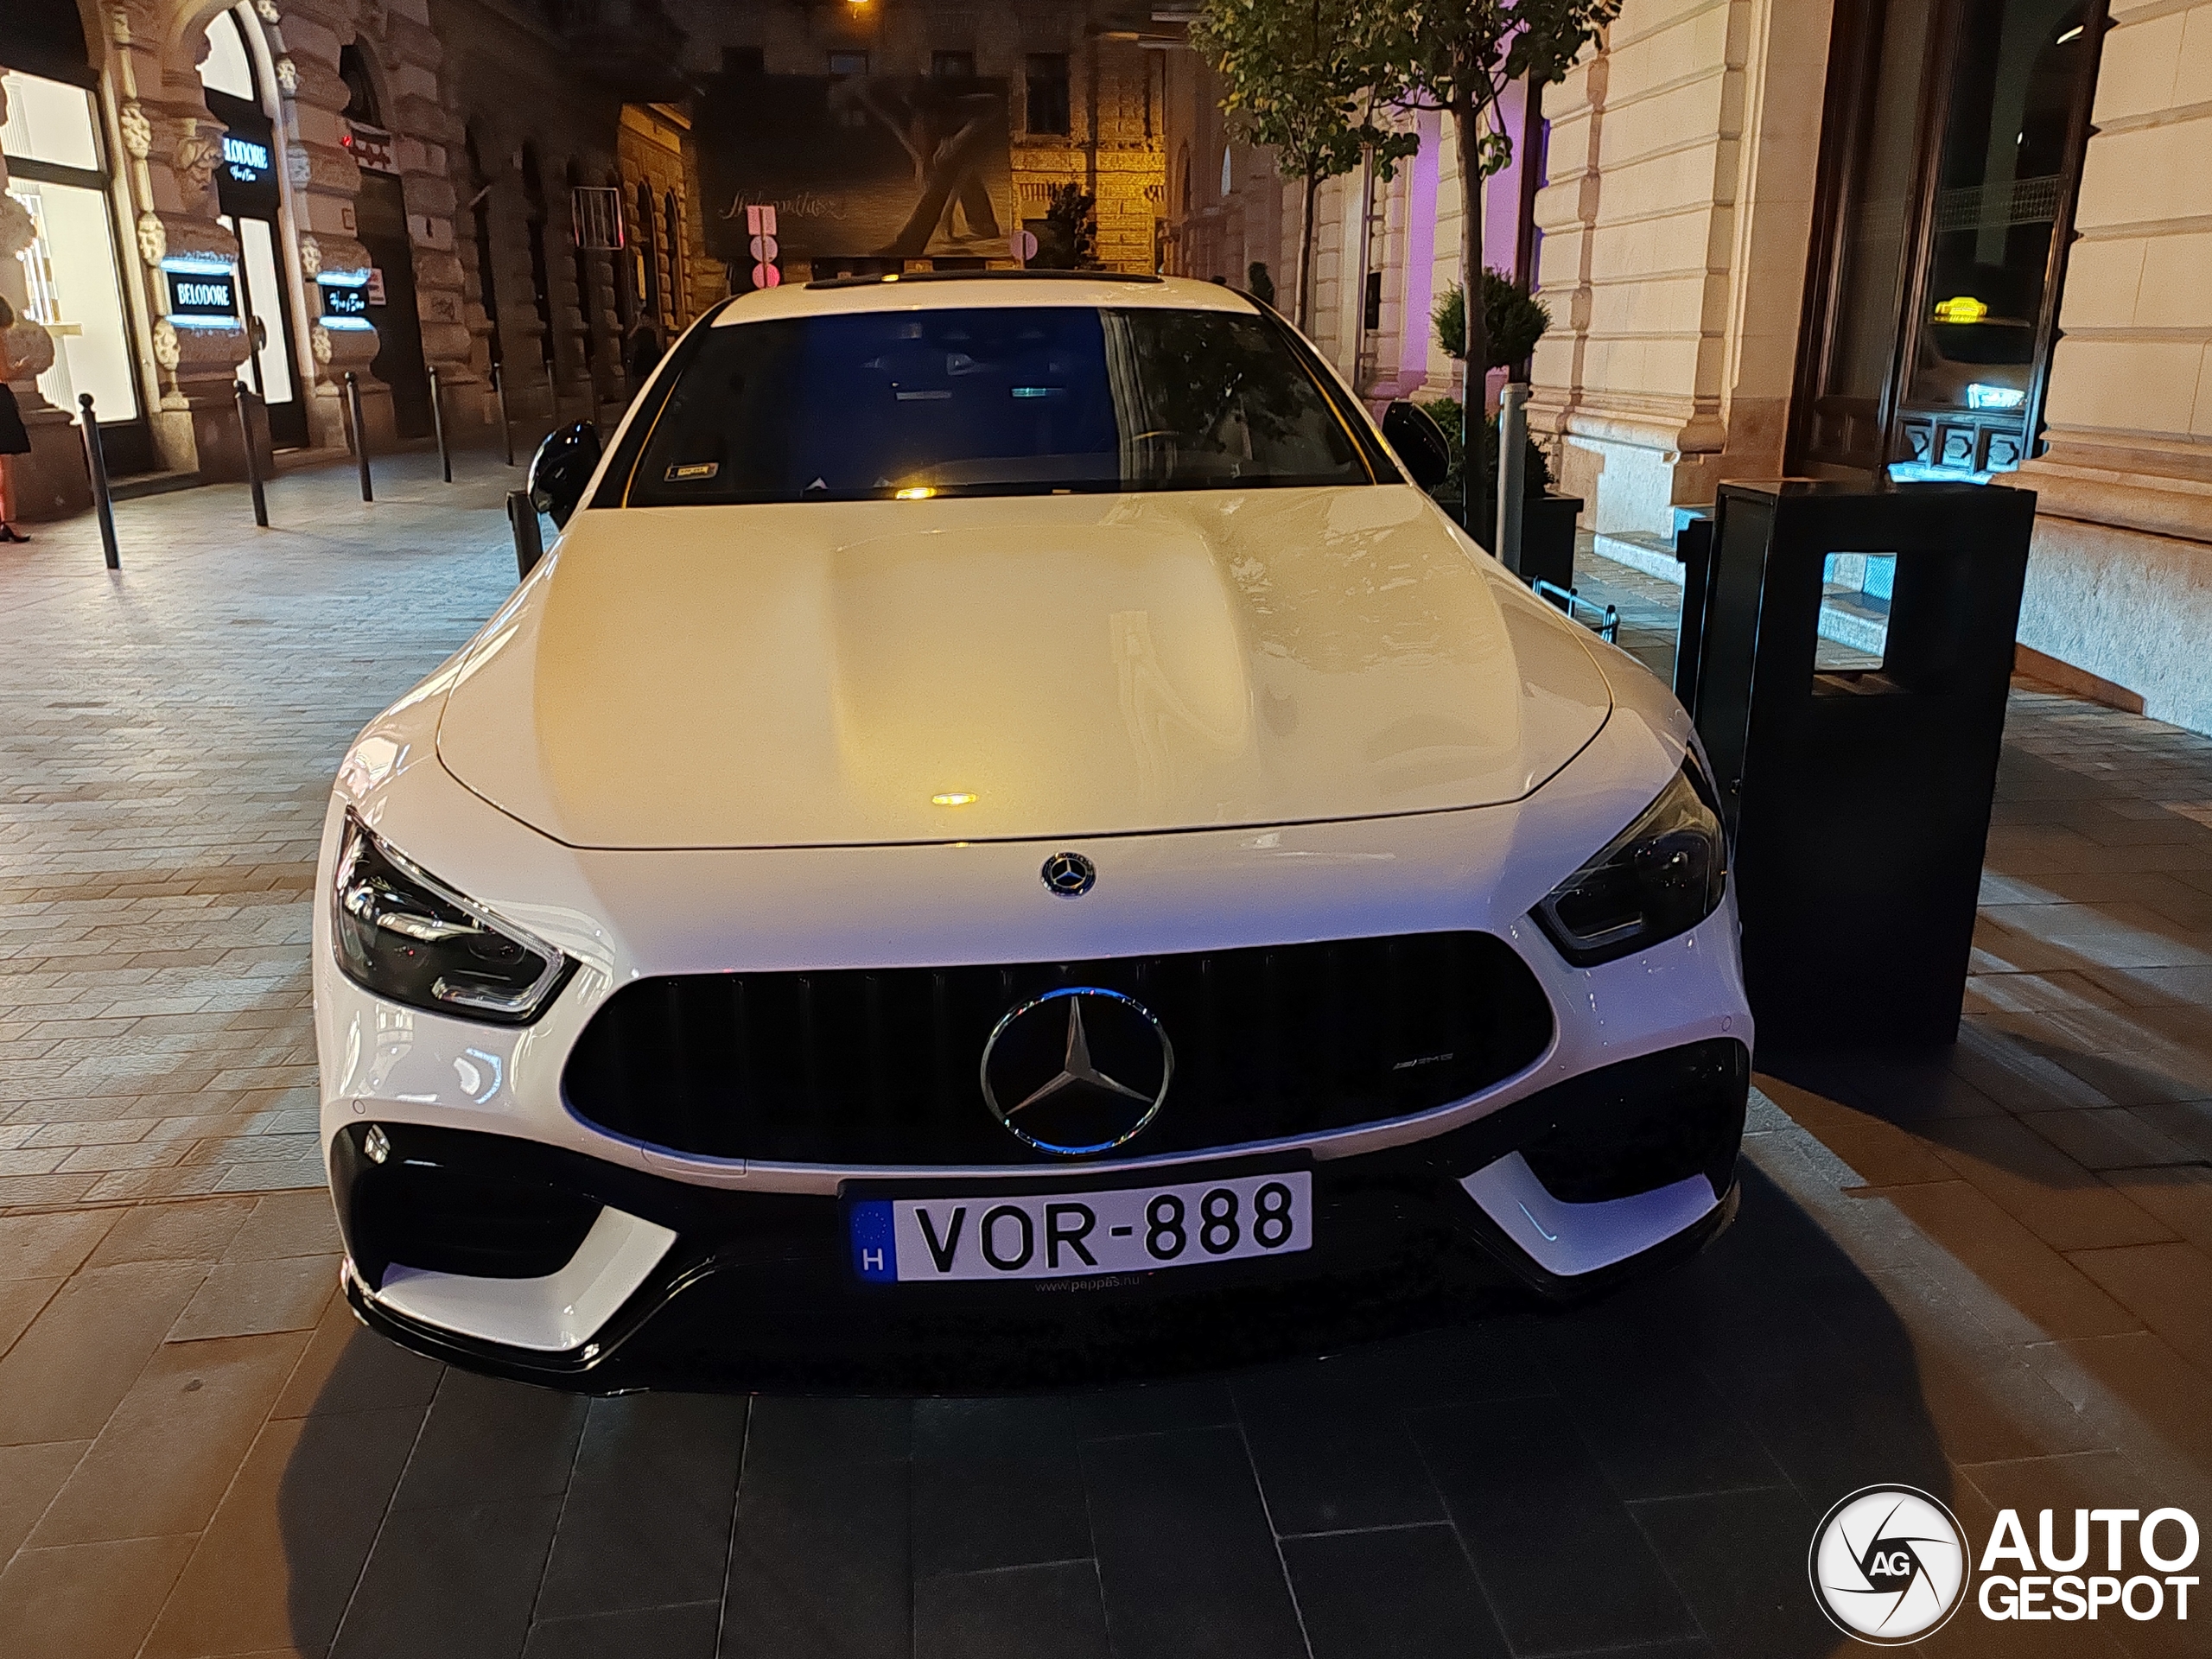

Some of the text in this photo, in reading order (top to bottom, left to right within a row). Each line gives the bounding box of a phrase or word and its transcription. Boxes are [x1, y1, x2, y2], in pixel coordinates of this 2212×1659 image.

[176, 283, 230, 307] BELODORE
[915, 1181, 1294, 1274] VOR-888
[862, 1248, 884, 1271] H
